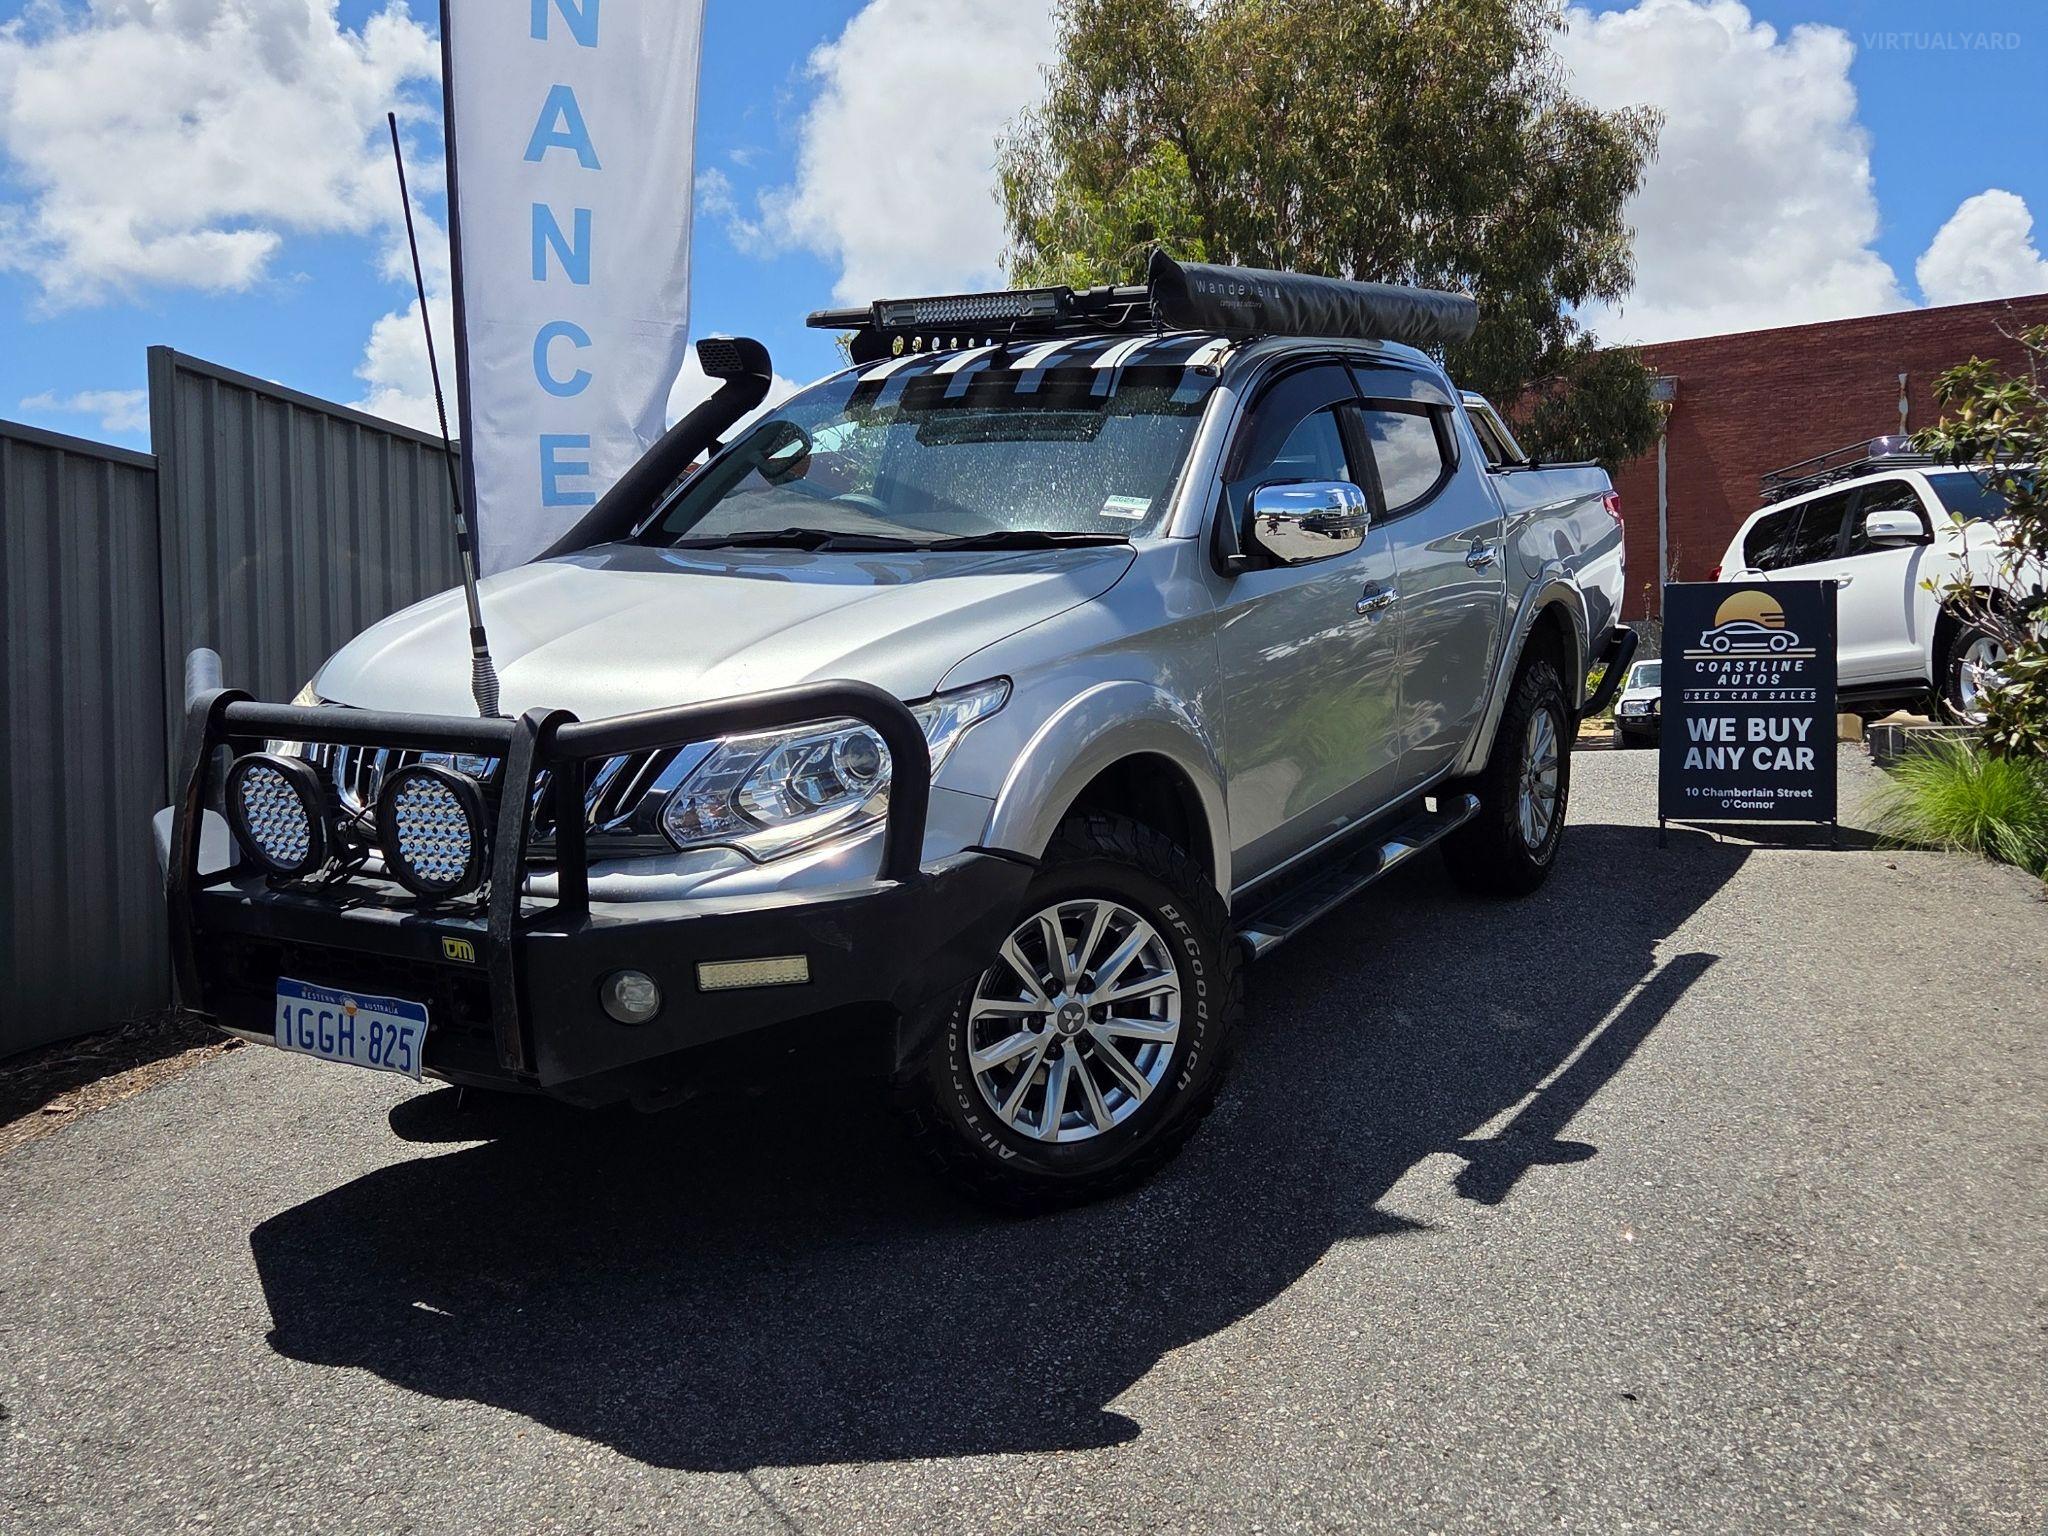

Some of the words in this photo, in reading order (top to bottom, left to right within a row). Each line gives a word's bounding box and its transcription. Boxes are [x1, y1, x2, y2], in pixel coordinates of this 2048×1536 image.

[1695, 660, 1805, 673] COASTLINE
[1717, 674, 1781, 686] AUTOS
[1684, 691, 1721, 700] USED
[1731, 691, 1759, 700] CAR
[1769, 691, 1817, 700] SALES
[1686, 717, 1737, 742] WE
[1747, 717, 1813, 742] BUY
[1683, 747, 1745, 771] ANY
[1752, 746, 1815, 771] CAR
[1685, 787, 1699, 797] 10
[1702, 787, 1774, 798] Chamberlain
[1777, 787, 1813, 798] Street
[1158, 904, 1209, 1091] BFGoodrich
[364, 1003, 399, 1015] AUSTRALIA
